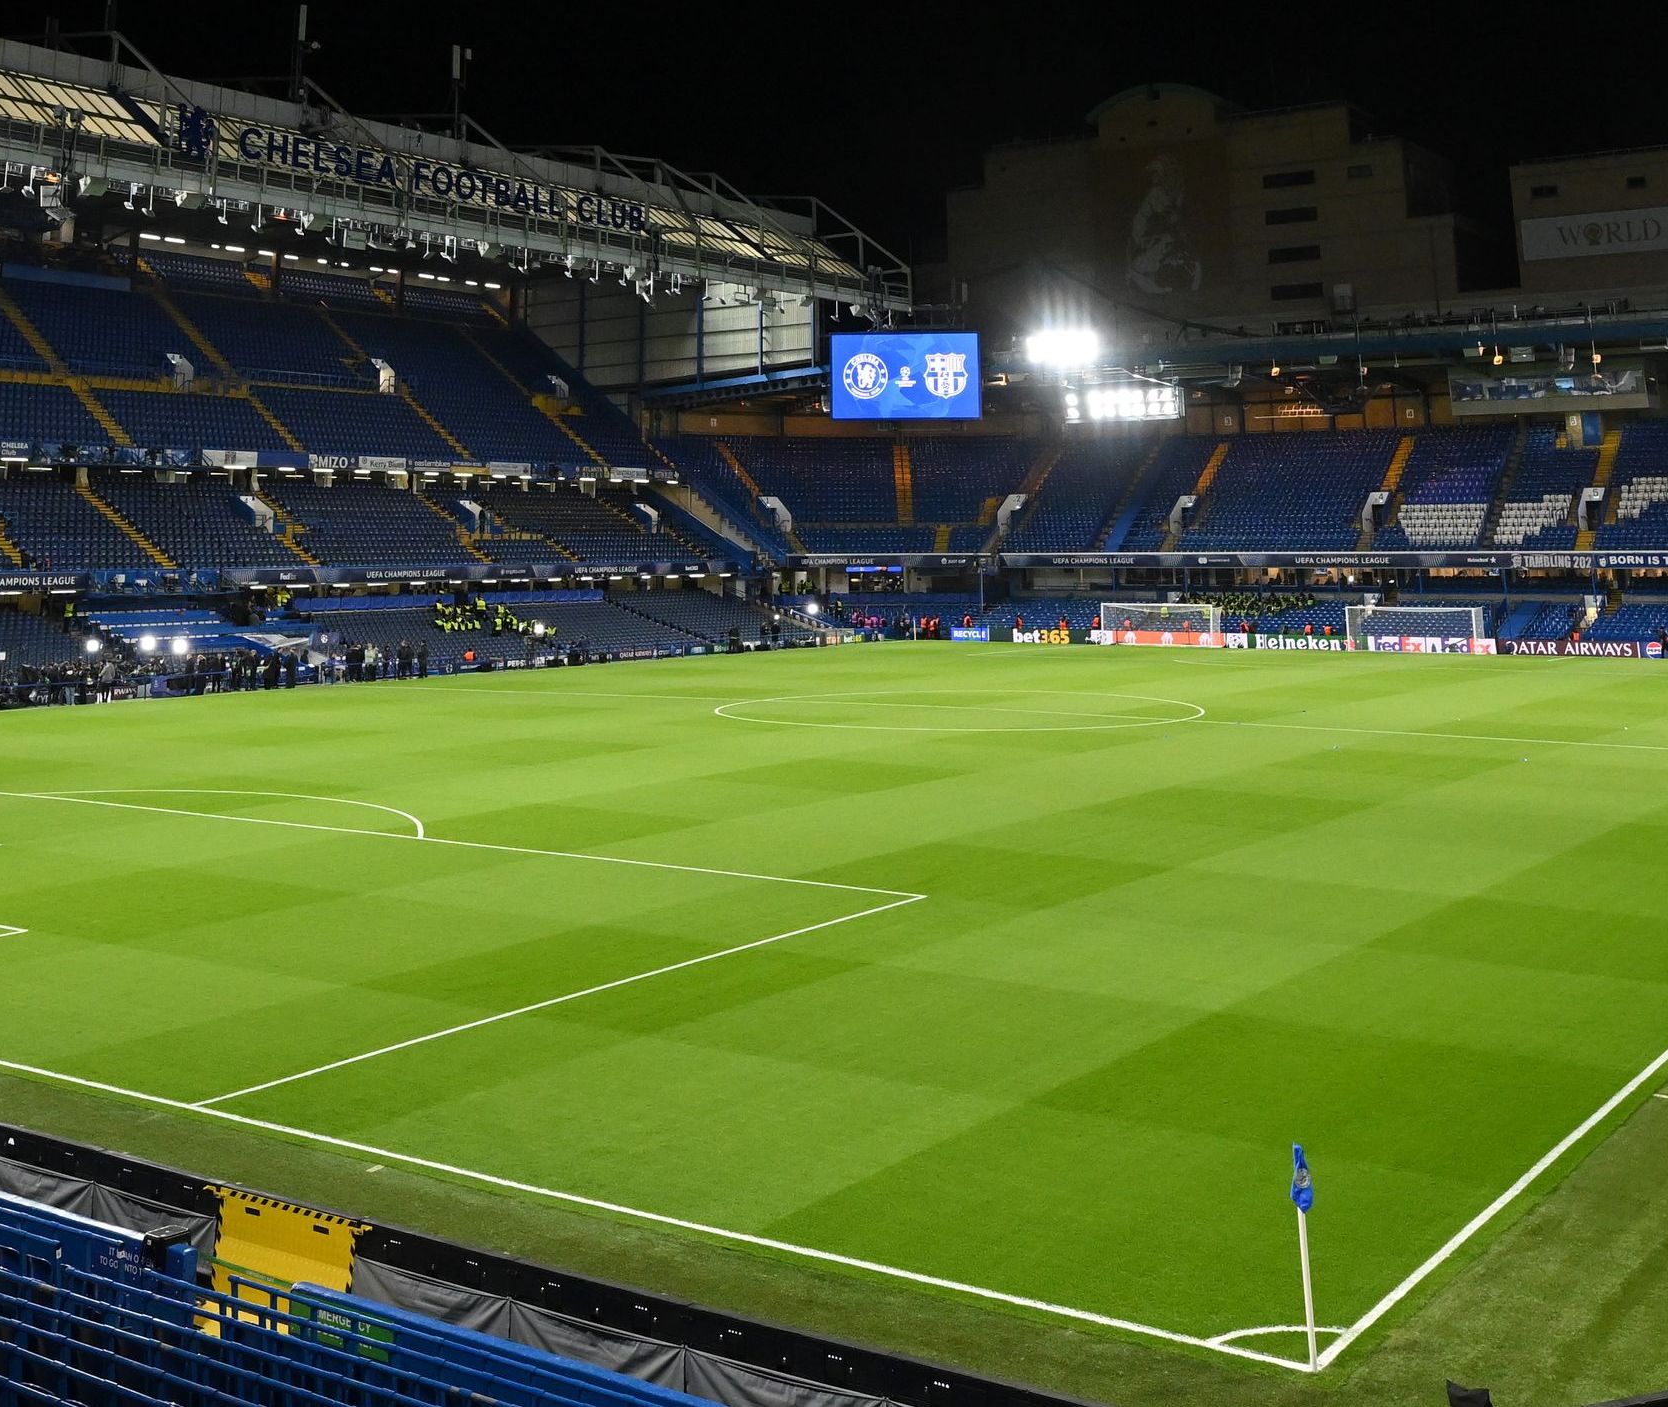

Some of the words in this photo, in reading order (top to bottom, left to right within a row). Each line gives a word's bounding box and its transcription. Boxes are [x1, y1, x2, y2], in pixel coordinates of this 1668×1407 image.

[239, 127, 398, 186] CHELSEA
[414, 161, 563, 218] FOOTBALL
[576, 195, 647, 232] CLUB
[0, 448, 17, 456] Club
[317, 455, 349, 469] MIZO
[1070, 557, 1108, 565] CHAMPIONS
[1109, 557, 1135, 565] LEAGUE
[1316, 556, 1359, 564] CHAMPIONS
[1523, 555, 1572, 568] TAMBLING
[1609, 555, 1644, 565] BORN
[1647, 555, 1660, 565] IS
[42, 576, 76, 585] LEAGUE
[366, 571, 383, 579] UEFA
[384, 570, 421, 578] CHAMPIONS
[422, 569, 447, 577] LEAGUE
[1012, 628, 1069, 644] bet365
[1255, 634, 1342, 650] Heineken
[1565, 642, 1633, 657] AIRWAYS
[99, 1256, 108, 1266] TO
[109, 1260, 119, 1270] GO
[317, 1309, 372, 1334] MERGECY
